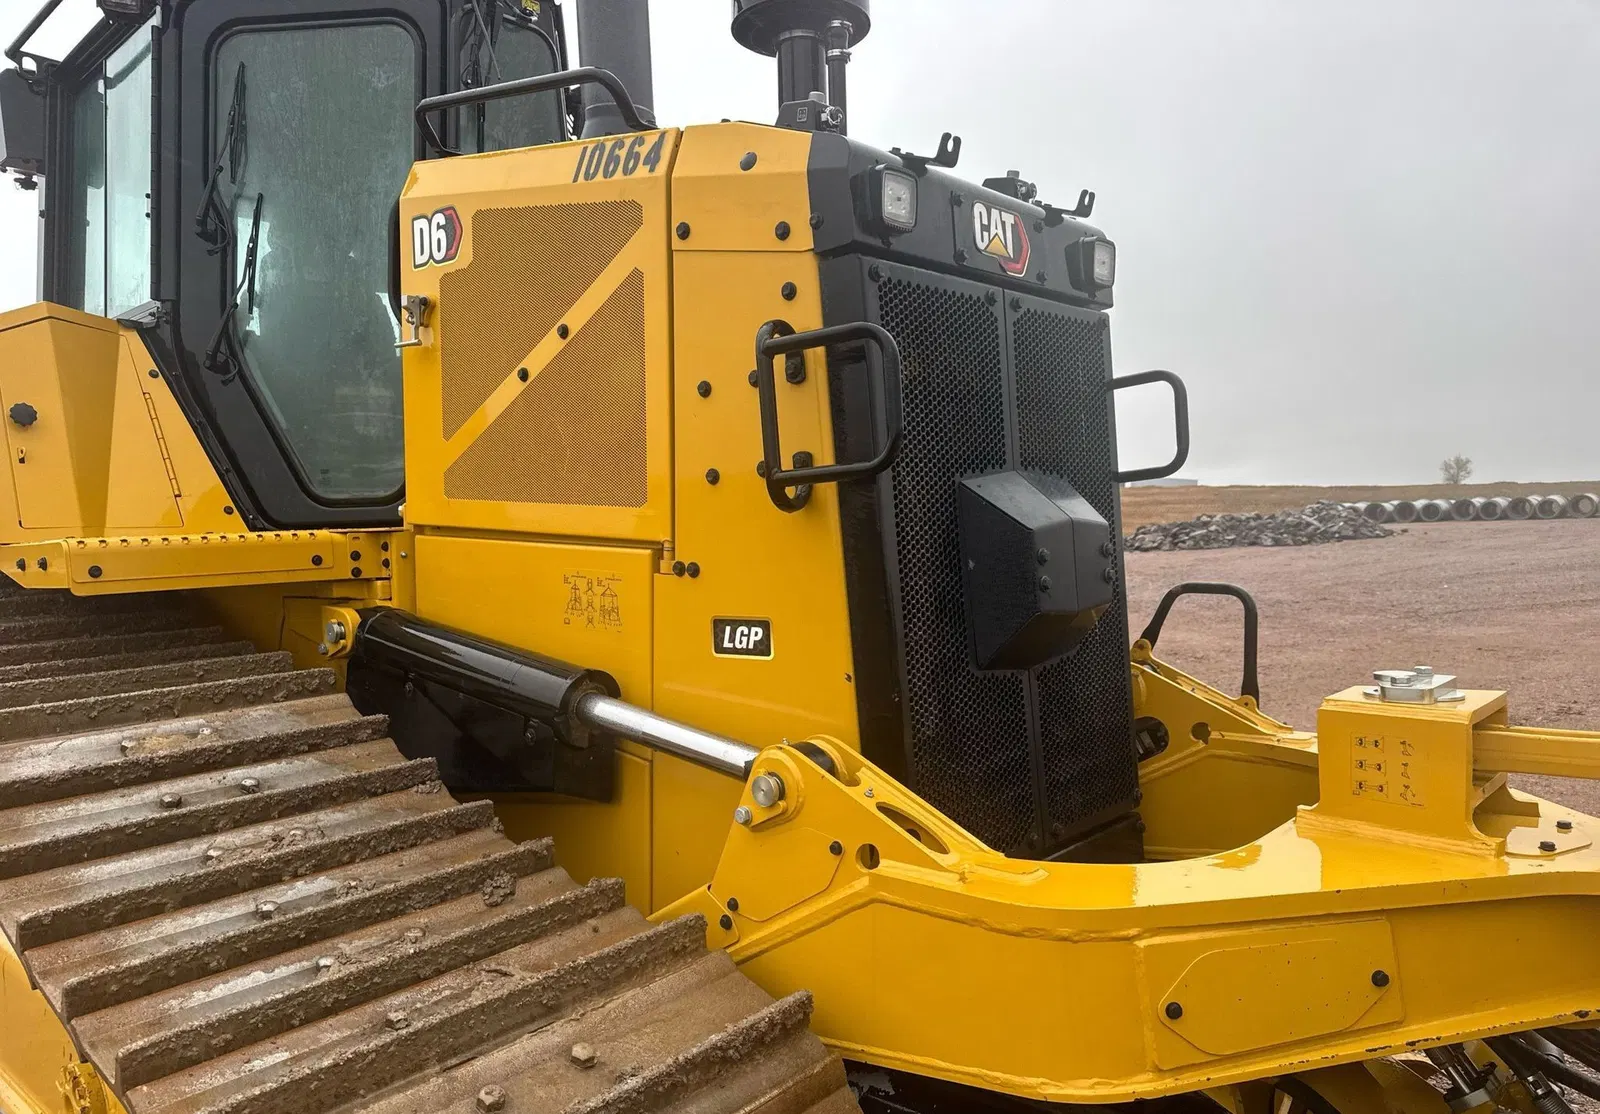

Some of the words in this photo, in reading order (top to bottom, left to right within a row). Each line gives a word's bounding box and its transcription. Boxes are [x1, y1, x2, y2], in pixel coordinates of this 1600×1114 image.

[572, 131, 667, 183] 10664
[413, 212, 447, 265] D6
[973, 202, 1015, 259] CAT
[723, 625, 763, 650] LGP
